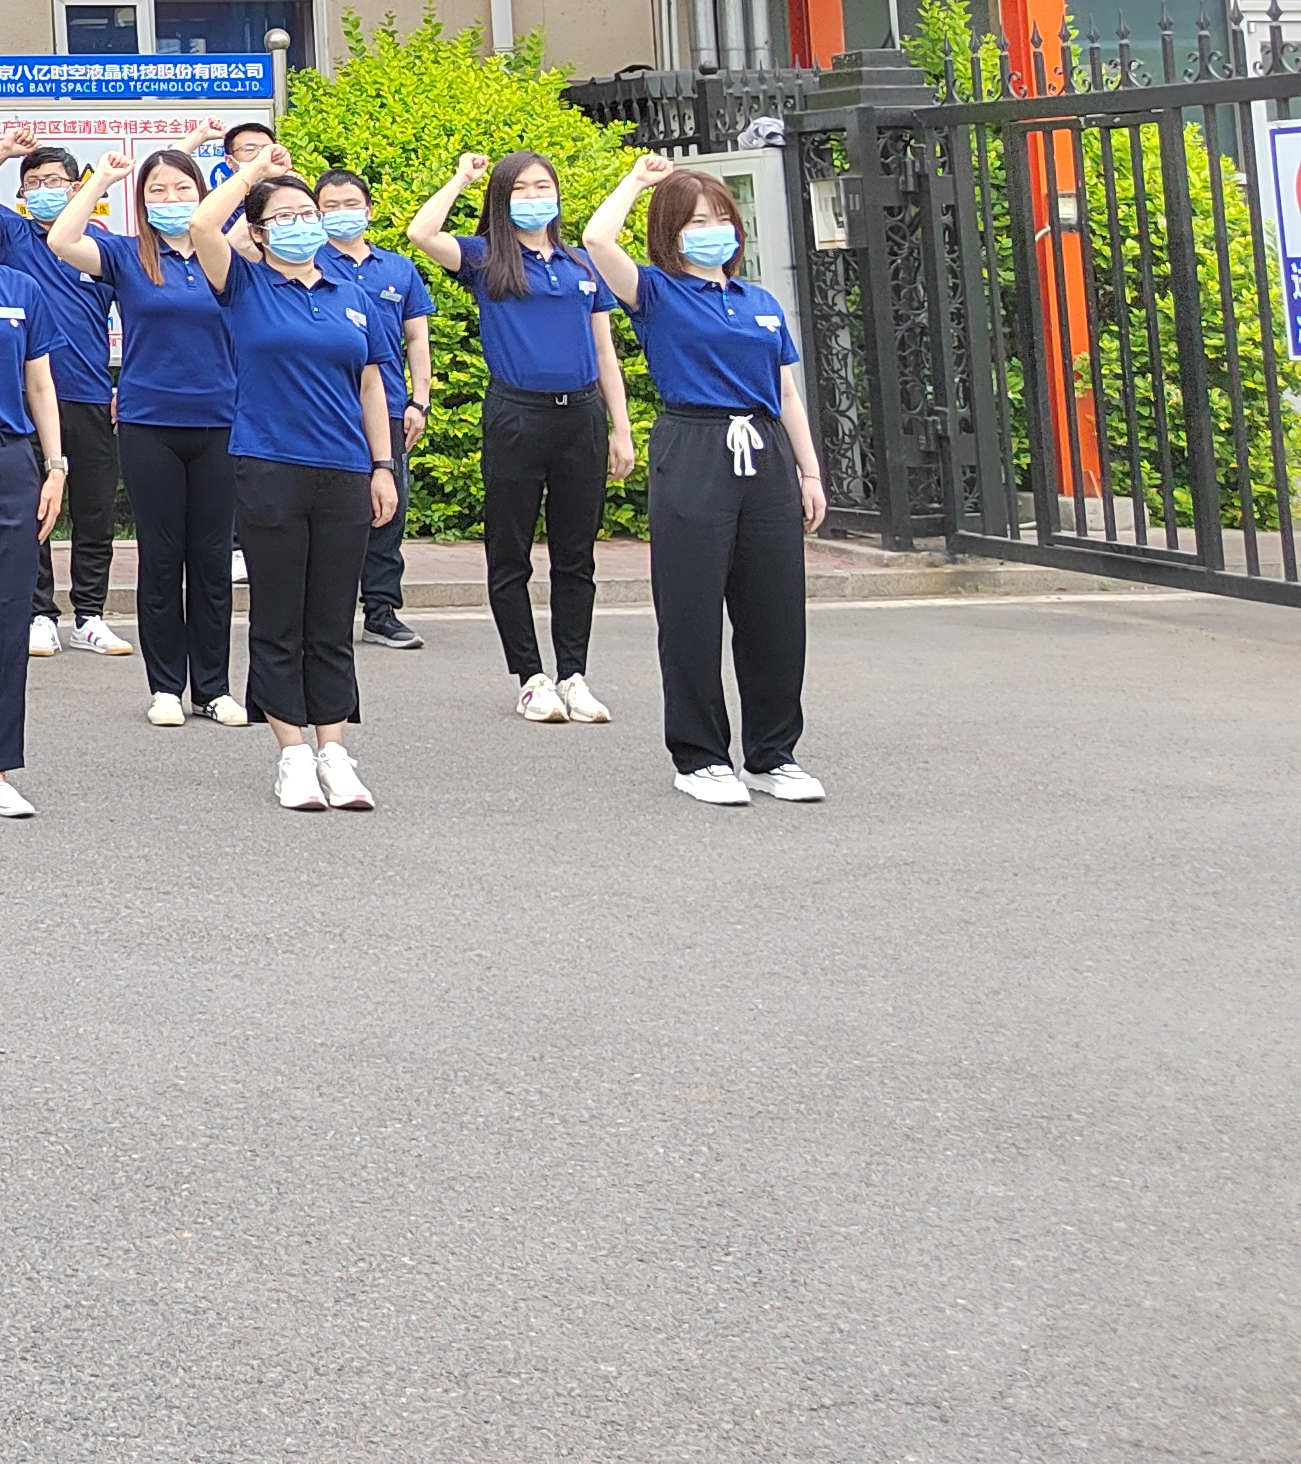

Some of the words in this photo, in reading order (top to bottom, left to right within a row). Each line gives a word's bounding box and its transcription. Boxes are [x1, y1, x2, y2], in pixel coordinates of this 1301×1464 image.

[29, 82, 56, 93] BAYI
[60, 81, 98, 93] SPACE
[102, 81, 125, 93] LCD
[129, 81, 209, 92] TECHNOLOGY
